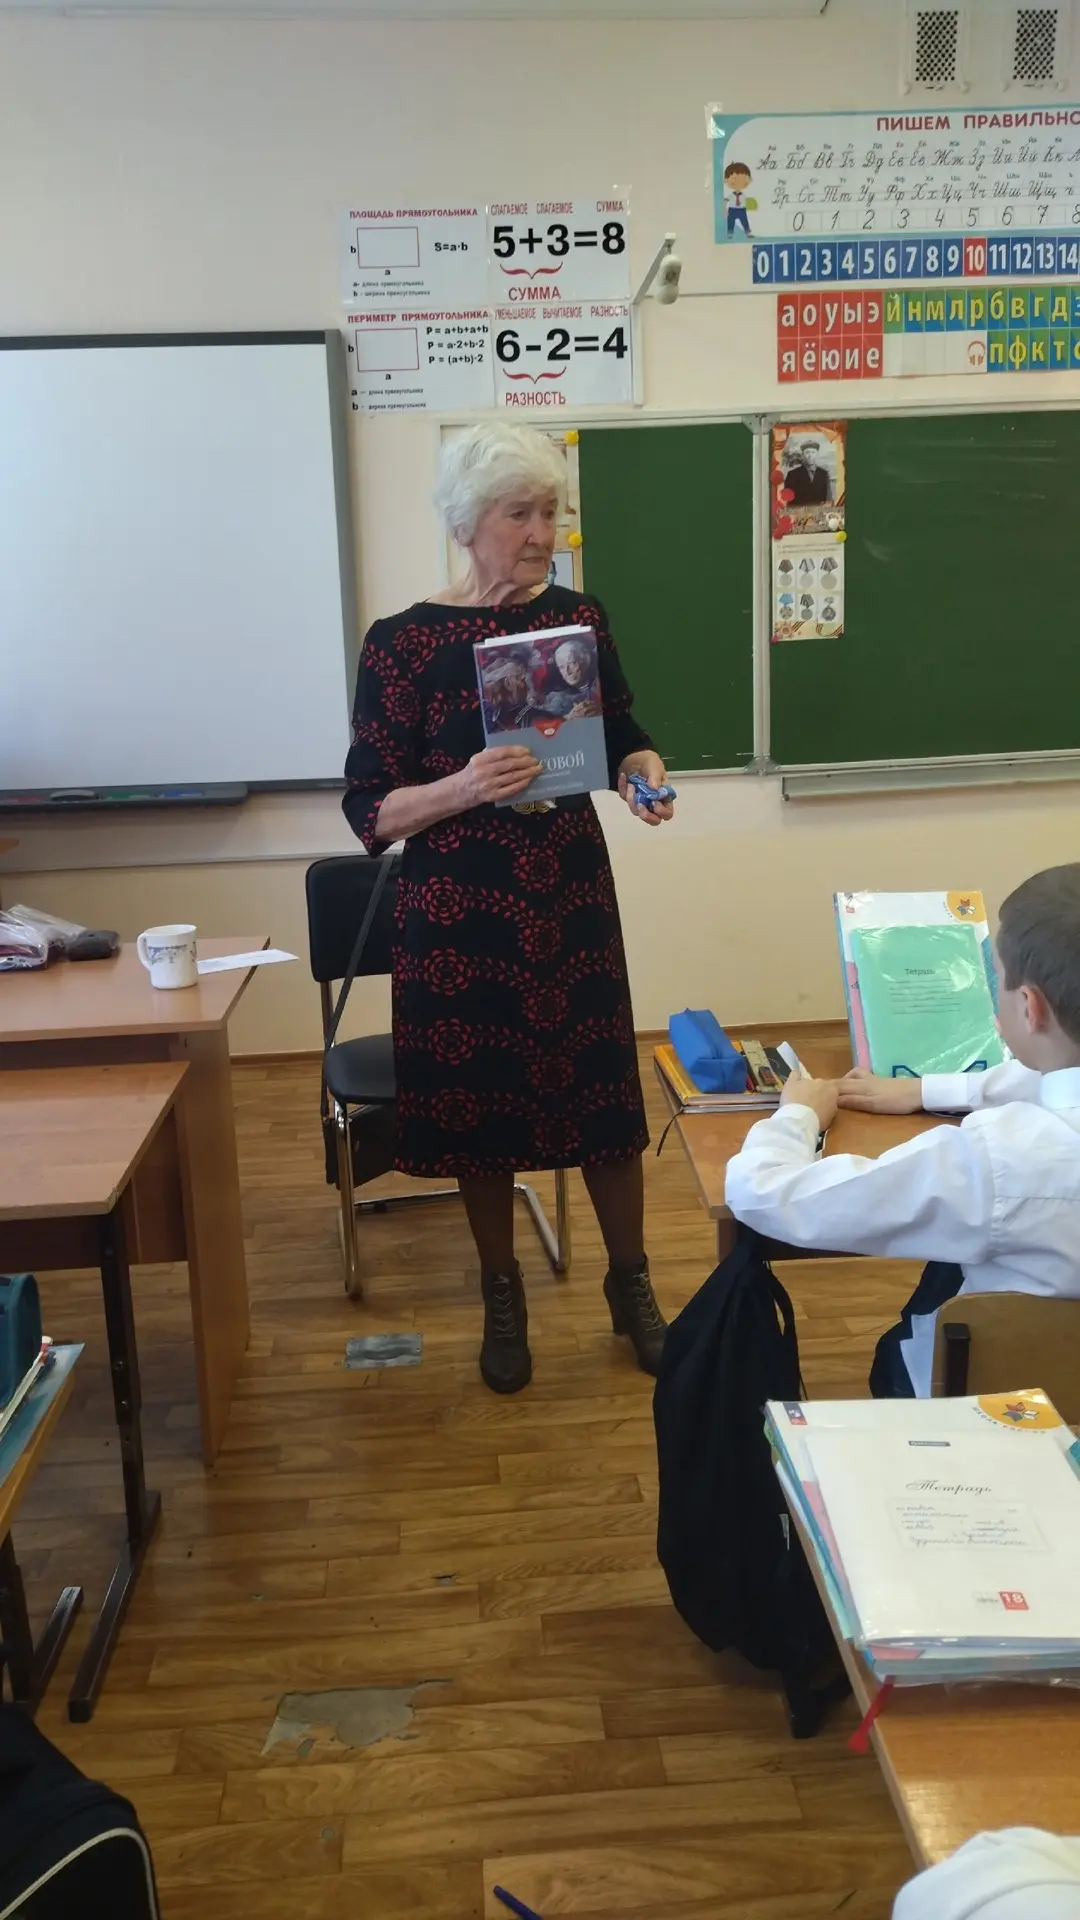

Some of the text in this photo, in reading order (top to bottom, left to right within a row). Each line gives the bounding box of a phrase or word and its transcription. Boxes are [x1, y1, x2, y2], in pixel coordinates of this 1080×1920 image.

[876, 110, 1080, 131] ПИШЕМ ПРАВИЛЬНО
[756, 153, 778, 170] Аа
[786, 152, 810, 170] Бб
[813, 151, 834, 169] Вв
[839, 151, 856, 168] Гг
[862, 150, 884, 173] Дд
[932, 148, 965, 167] Жж
[968, 147, 986, 171] Зз
[993, 147, 1012, 165] Ии
[1043, 145, 1064, 163] Кк
[819, 185, 852, 203] Тт
[858, 184, 876, 207] Уу
[884, 184, 905, 206] Фф
[911, 182, 937, 200] Хх
[942, 183, 963, 203] Цц
[968, 181, 987, 199] Чч
[993, 180, 1022, 198] Шш
[1028, 180, 1057, 200] Щщ
[349, 207, 479, 219] ПЛОЩАДЬ ПРЯМОУГОЛЬНИКА
[490, 200, 624, 216] СЛАГАЕМОЕ СЛАГАЕМОЕ СУММА
[792, 211, 805, 232] 0
[831, 210, 841, 230] 1
[862, 209, 876, 230] 2
[897, 208, 910, 229] 3
[934, 207, 946, 228] 4
[966, 207, 980, 227] 5
[1001, 205, 1014, 226] 6
[1037, 204, 1049, 225] 7
[350, 245, 357, 254] b
[757, 242, 1079, 278] 0 1 2 3 4 5 6 7 8 9 10 11 12 13 14
[508, 286, 562, 302] СУММА
[347, 310, 489, 324] ПЕРИМЕТР ПРЯМОУГОЛЬНИКА
[590, 305, 629, 318] РАЗНОСТЬ
[781, 304, 796, 328] а
[802, 303, 817, 327] о
[824, 302, 839, 333] у
[843, 302, 862, 324] ы
[867, 301, 880, 324] э
[886, 292, 901, 323] й
[907, 300, 922, 322] н
[926, 299, 944, 321] м
[949, 299, 964, 321] л
[970, 298, 984, 328] р
[990, 290, 1005, 320] б
[1011, 297, 1025, 319] в
[1034, 296, 1045, 317] г
[1051, 296, 1068, 323] д
[347, 345, 354, 353] b
[781, 341, 880, 373] я ё ю и е
[989, 342, 1004, 364] п
[1009, 334, 1027, 371] ф
[1032, 341, 1045, 362] к
[1053, 340, 1066, 361] т
[505, 391, 567, 407] РАЗНОСТЬ
